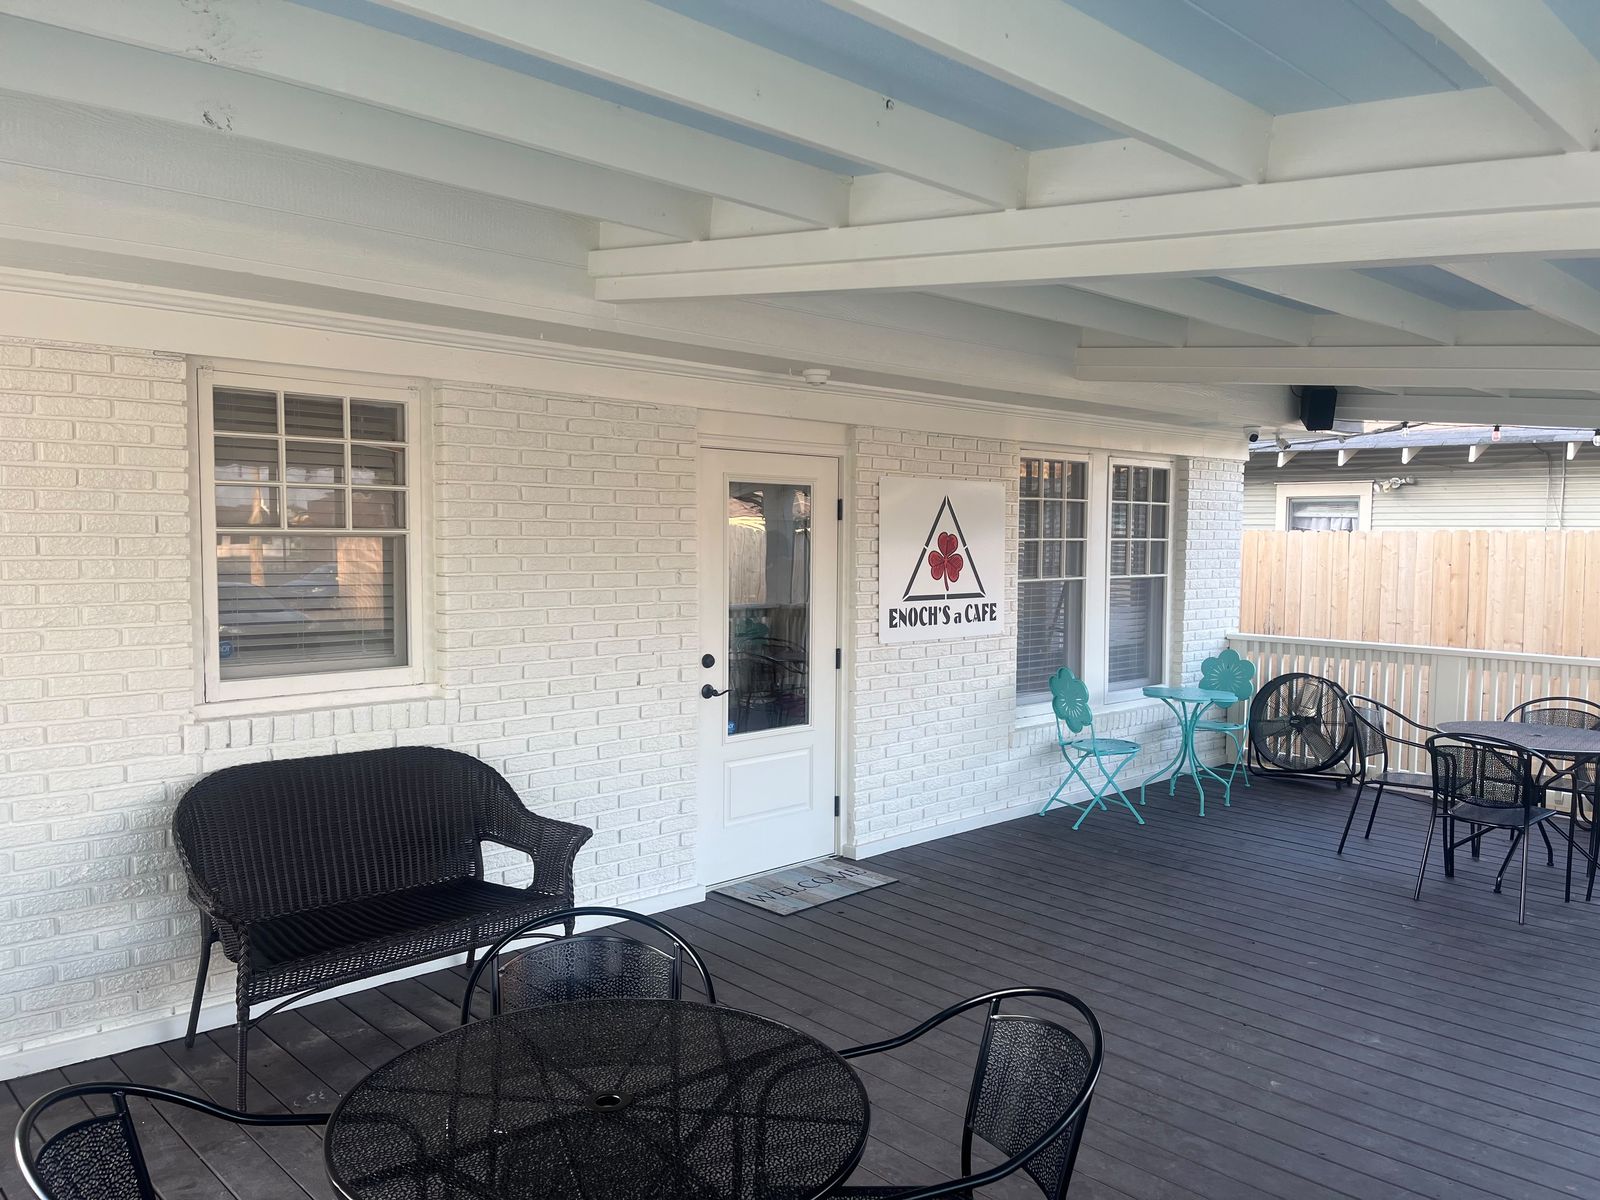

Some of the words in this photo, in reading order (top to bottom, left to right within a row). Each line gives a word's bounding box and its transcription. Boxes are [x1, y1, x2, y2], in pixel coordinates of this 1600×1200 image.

[888, 605, 951, 628] ENOCH'S
[953, 612, 962, 624] a
[964, 602, 997, 623] CAFE
[747, 868, 867, 902] WELCOME
